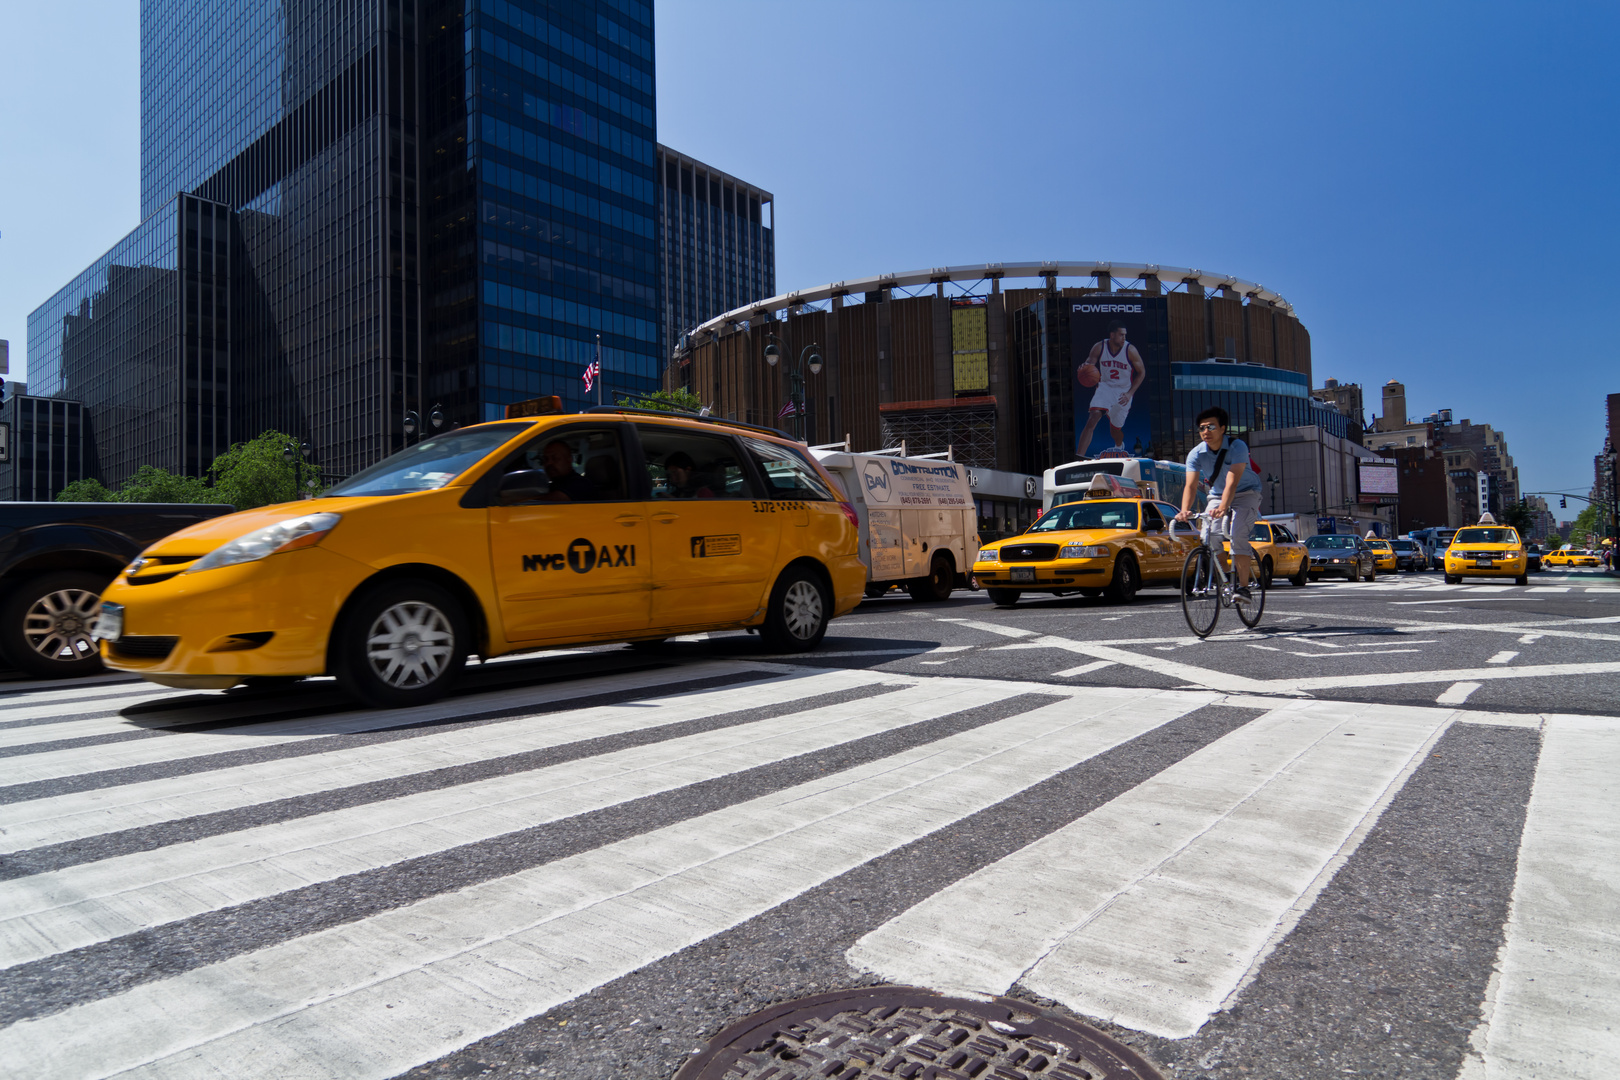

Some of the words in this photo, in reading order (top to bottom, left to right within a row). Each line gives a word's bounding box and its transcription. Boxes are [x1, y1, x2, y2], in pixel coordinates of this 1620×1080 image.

[1072, 304, 1142, 313] POWERADE
[1101, 360, 1111, 368] NEW
[1112, 360, 1128, 370] YORK
[1109, 369, 1120, 380] 2
[912, 483, 927, 491] FREE
[927, 484, 950, 492] ESTIMATE
[522, 553, 565, 572] NYC
[569, 540, 636, 571] TAXI
